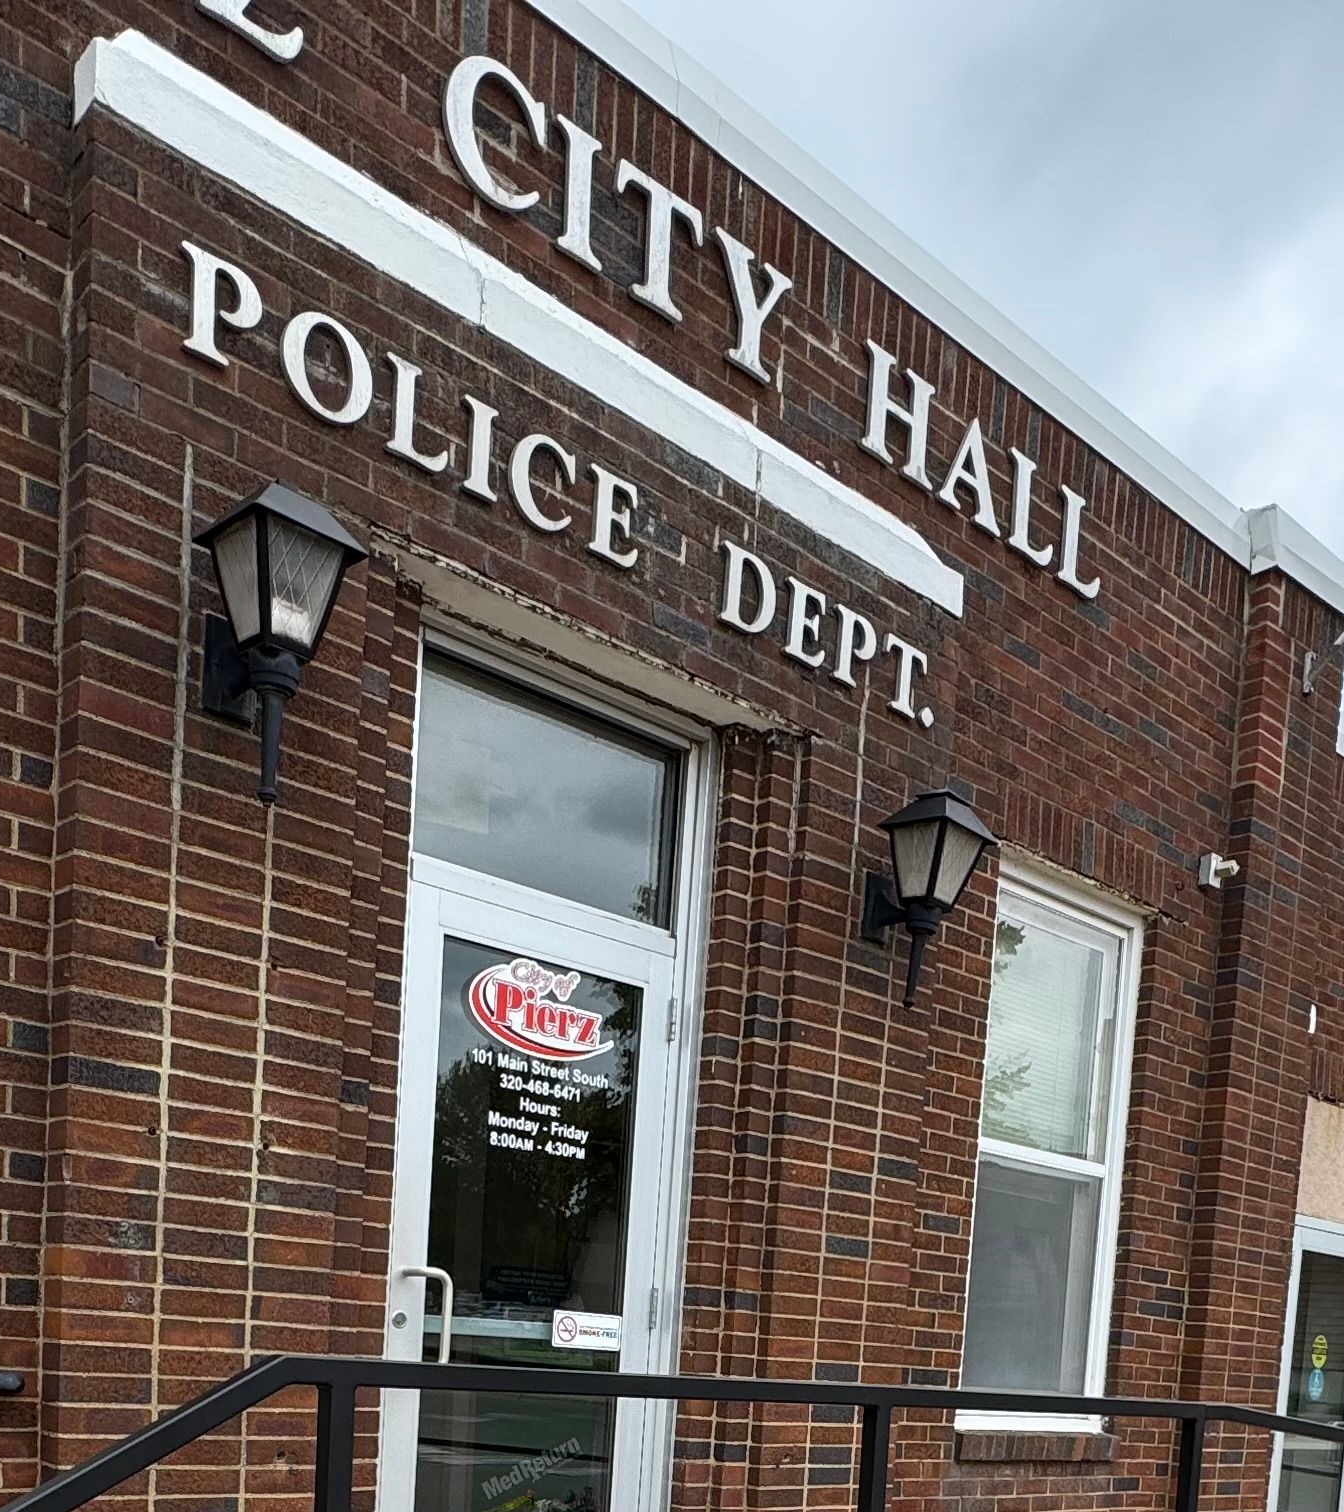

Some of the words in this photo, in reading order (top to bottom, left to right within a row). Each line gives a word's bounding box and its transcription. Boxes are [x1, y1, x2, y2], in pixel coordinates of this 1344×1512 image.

[442, 54, 794, 385] CITY
[859, 337, 1103, 600] HALL
[180, 240, 641, 571] POLICE
[717, 539, 938, 731] DEPT.
[510, 961, 553, 992] City
[555, 973, 579, 998] of
[490, 977, 599, 1048] Pierz
[471, 1047, 494, 1066] 101
[497, 1052, 529, 1073] Main
[531, 1060, 570, 1082] Street
[572, 1068, 610, 1090] South
[499, 1073, 582, 1104] 320-468-6471
[519, 1096, 562, 1118] Hours:
[488, 1110, 540, 1137] Monday
[550, 1121, 590, 1145] Friday
[489, 1130, 534, 1152] 8:00AM
[544, 1140, 586, 1160] 4:30PM
[480, 1437, 582, 1500] MedReturn
